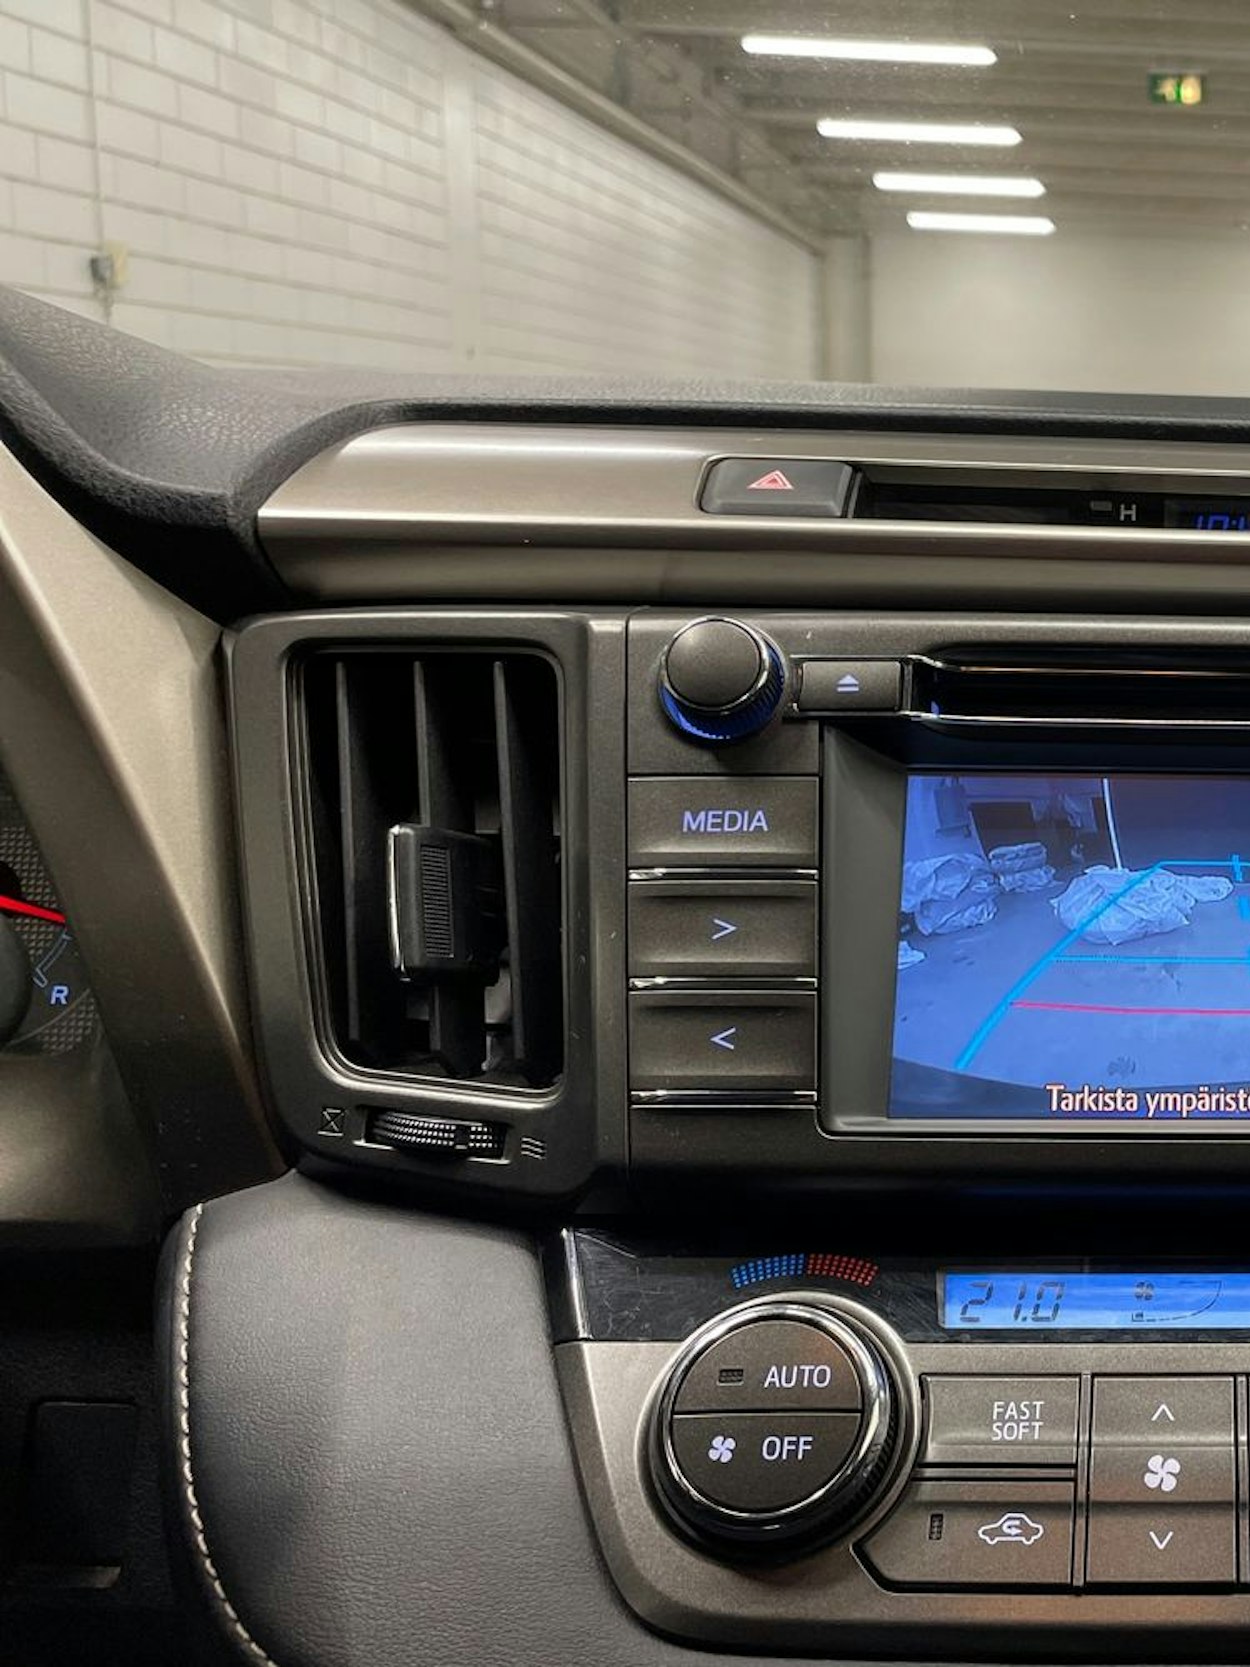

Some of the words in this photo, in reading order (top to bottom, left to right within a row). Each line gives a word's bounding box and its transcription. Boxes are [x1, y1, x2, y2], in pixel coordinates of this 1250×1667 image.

[682, 810, 768, 832] MEDIA
[50, 985, 69, 1005] R
[1046, 1084, 1138, 1112] Tarkista
[959, 1281, 1065, 1322] 21.0
[763, 1364, 832, 1388] AUTO
[992, 1400, 1045, 1419] FAST
[991, 1421, 1044, 1441] SOFT
[762, 1436, 813, 1461] OFF
